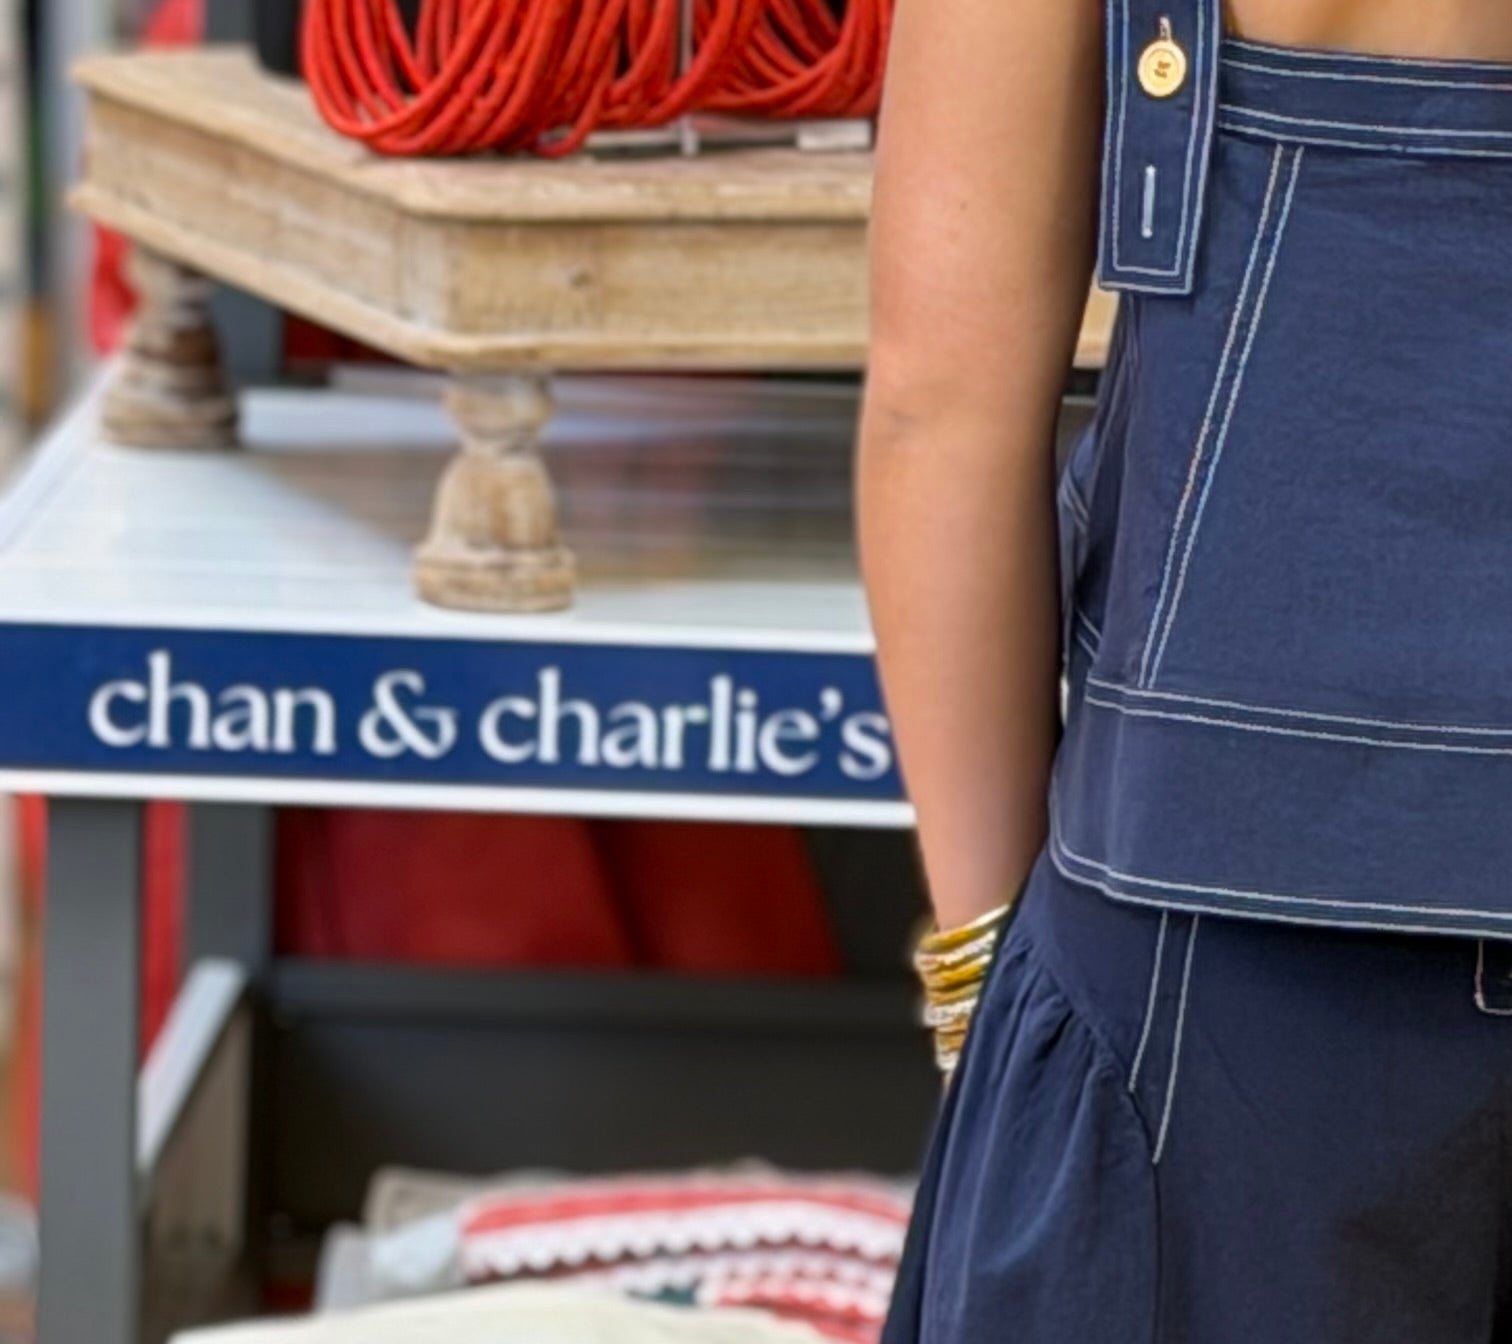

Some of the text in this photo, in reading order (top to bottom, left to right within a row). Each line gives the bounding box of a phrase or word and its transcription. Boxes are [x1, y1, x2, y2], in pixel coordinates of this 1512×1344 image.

[87, 649, 893, 779] chan & charlie's
